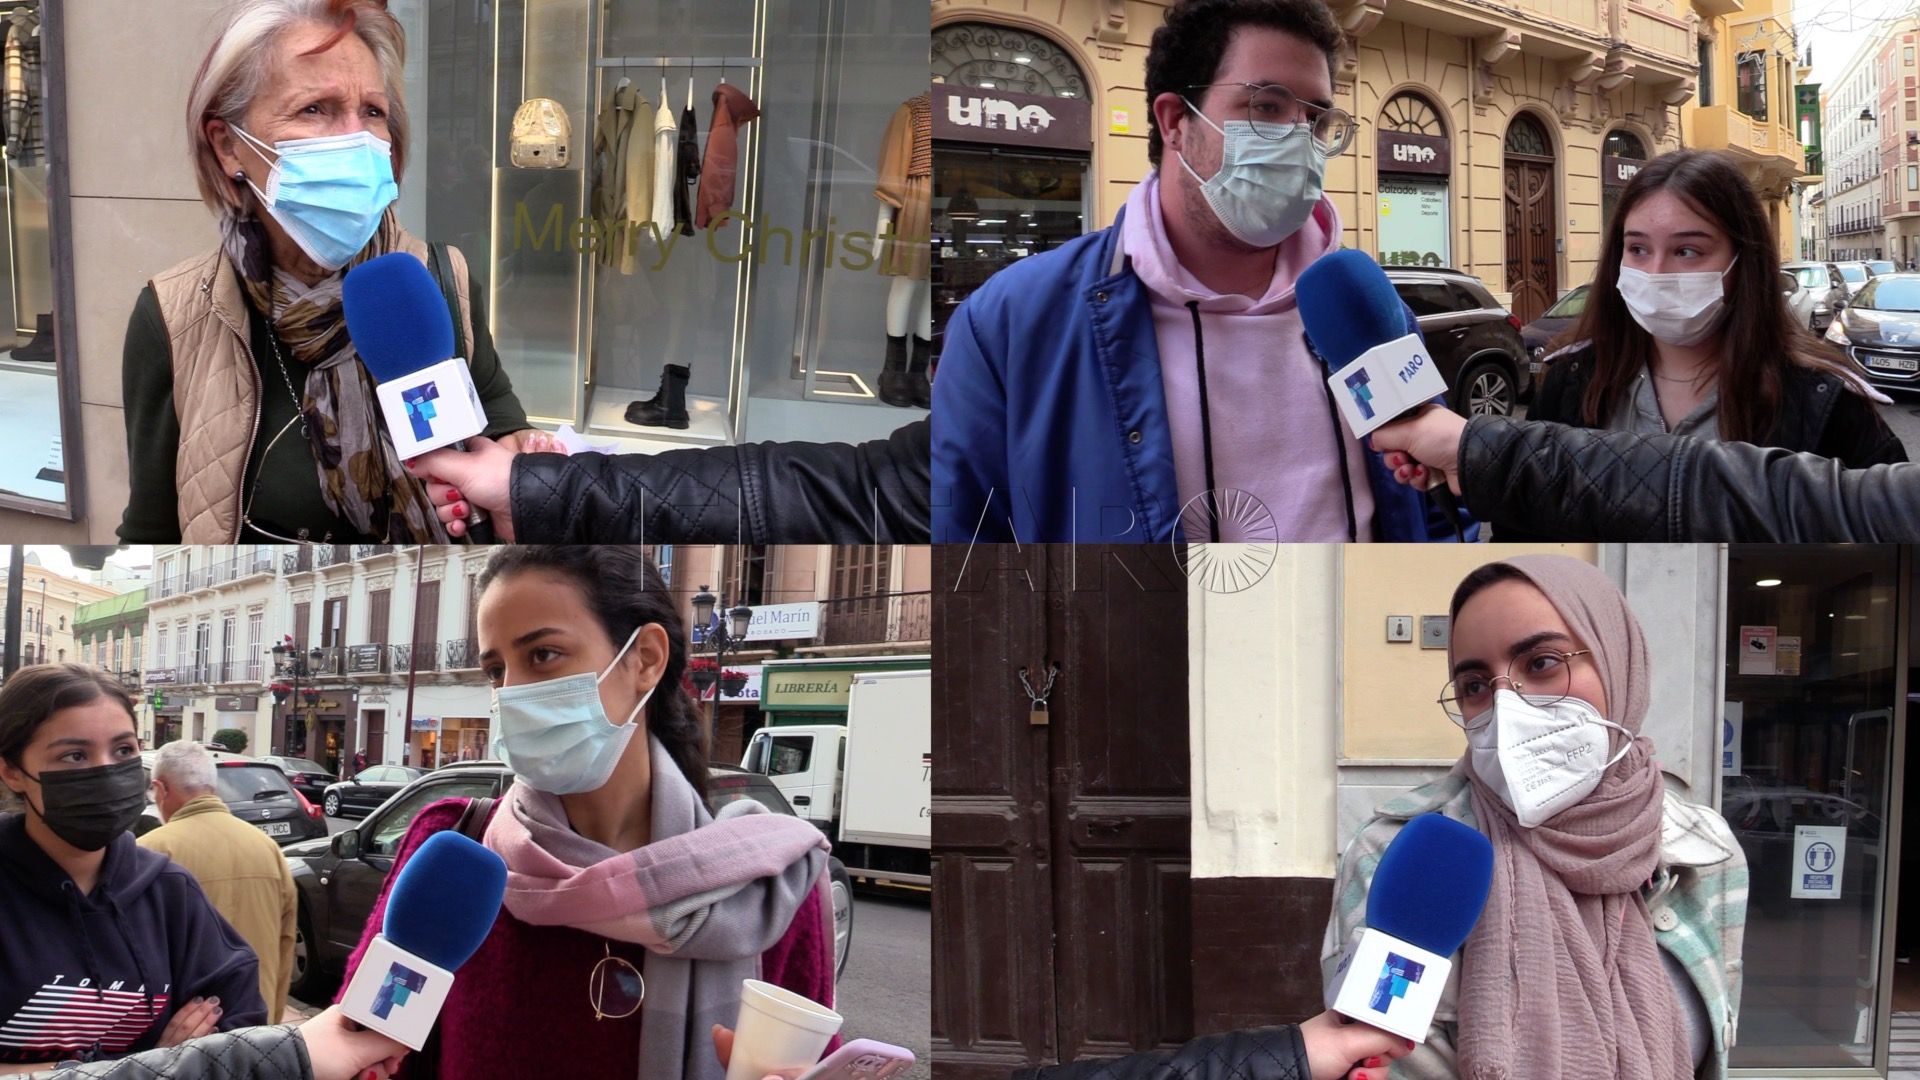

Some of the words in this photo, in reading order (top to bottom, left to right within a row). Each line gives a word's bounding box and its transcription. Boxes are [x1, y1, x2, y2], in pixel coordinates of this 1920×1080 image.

[947, 95, 1057, 134] uno
[1392, 143, 1437, 163] uno
[1617, 164, 1642, 181] un
[1377, 184, 1418, 195] Calzados
[513, 201, 684, 272] Merry
[1398, 354, 1423, 384] FARO
[770, 609, 810, 624] Marín
[774, 680, 838, 694] LIBRERÍA
[1566, 742, 1593, 763] FFP2
[272, 823, 289, 834] HCC
